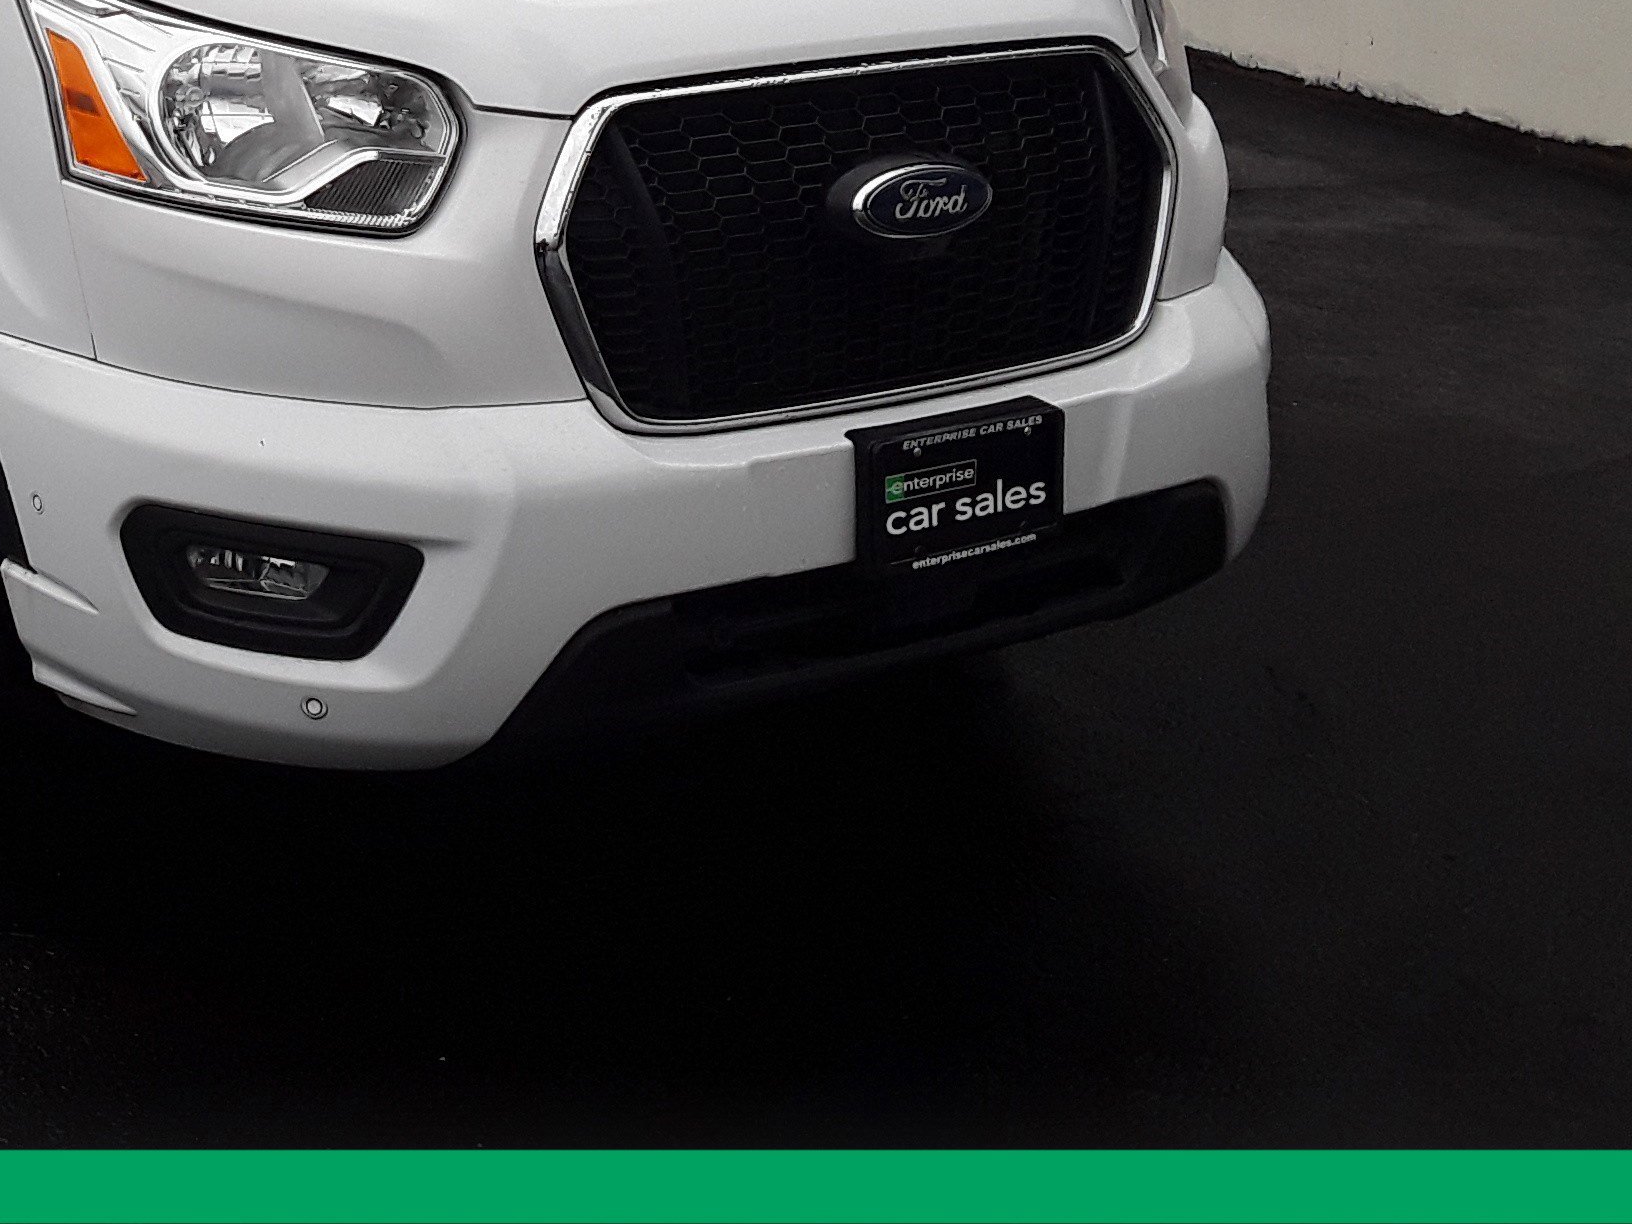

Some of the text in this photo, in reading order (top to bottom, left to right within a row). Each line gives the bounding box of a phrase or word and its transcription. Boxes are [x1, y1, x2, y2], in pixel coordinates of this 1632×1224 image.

[895, 177, 969, 220] Ford
[903, 414, 1043, 450] ENTERPRISE CAR SALES
[889, 467, 975, 495] enterprise
[885, 478, 1047, 536] car sales
[911, 532, 1037, 570] enterprisecarsales.com
